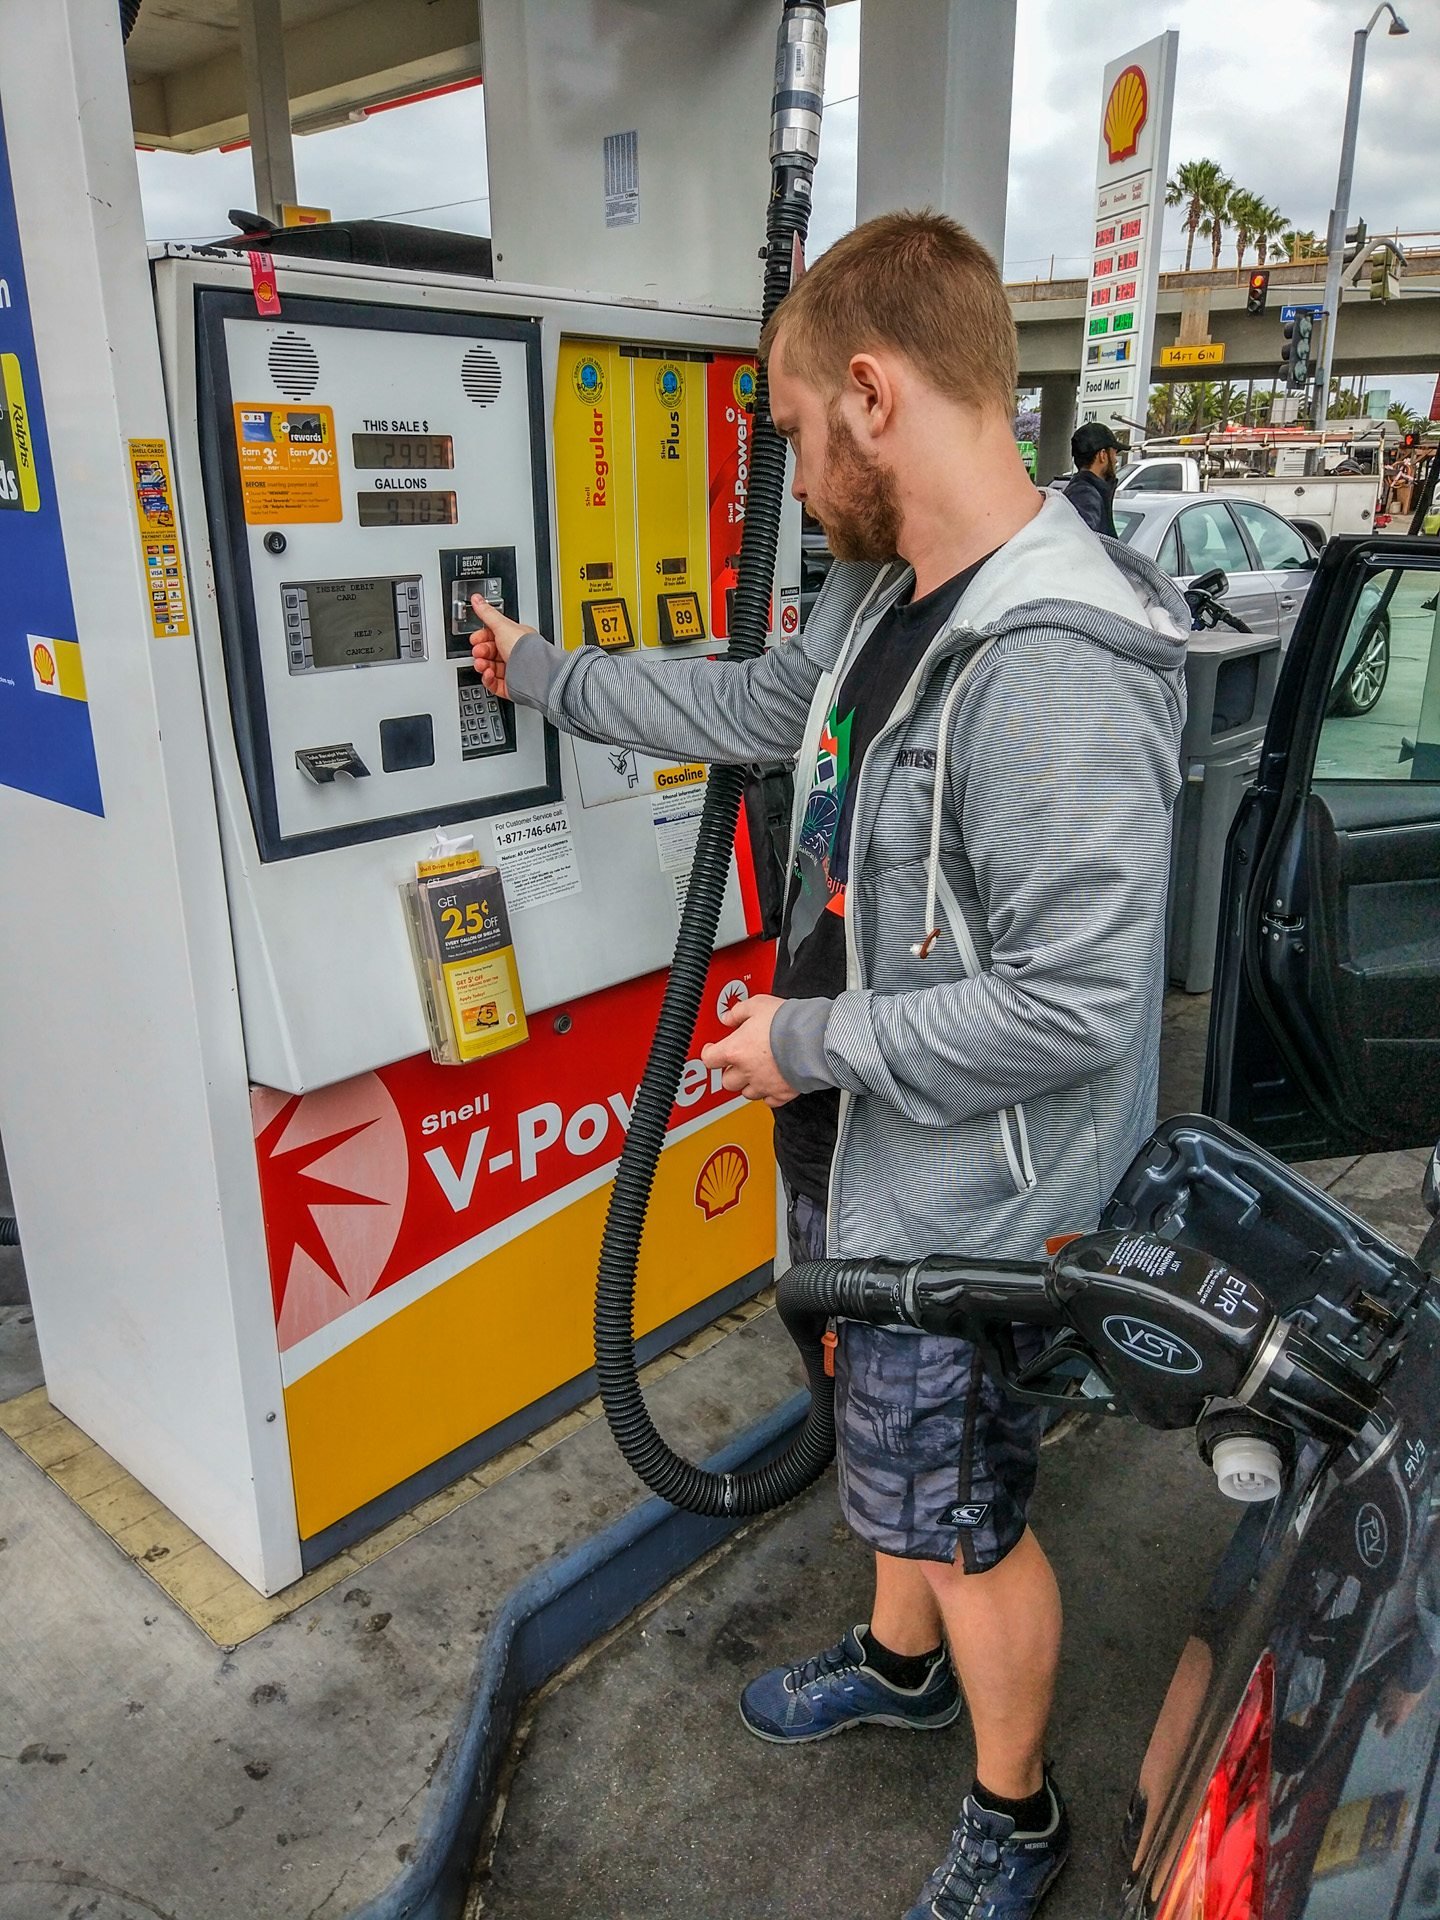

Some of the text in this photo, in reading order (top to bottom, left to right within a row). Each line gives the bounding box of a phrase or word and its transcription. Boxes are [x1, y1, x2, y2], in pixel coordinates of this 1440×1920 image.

[1086, 379, 1120, 392] Food Mart
[1084, 411, 1097, 422] ATM
[363, 420, 429, 433] THIS SALE $
[12, 402, 29, 468] Ralphs
[290, 433, 321, 442] rewards
[667, 411, 680, 459] Plus
[242, 447, 260, 456] Earn
[290, 448, 308, 457] Earn
[590, 408, 608, 506] Regular
[735, 414, 748, 524] V-Power
[374, 478, 427, 489] GALLONS
[580, 565, 585, 580] $
[656, 561, 661, 575] $
[316, 583, 374, 594] INSERT DEBIT
[336, 593, 356, 602] CARD
[676, 610, 692, 625] 89
[601, 617, 618, 633] 87
[354, 629, 372, 638] HELP
[346, 647, 375, 656] CANCEL
[657, 768, 704, 786] Gasoline
[505, 817, 532, 829] Customer
[533, 812, 553, 822] Service
[497, 820, 567, 846] 1-877-746-6472
[548, 839, 568, 848] Customers
[438, 895, 457, 908] GET
[440, 900, 498, 939] 25¢ OFF
[486, 1009, 493, 1019] 5
[421, 1093, 490, 1136] Shell
[1156, 1250, 1176, 1276] WARNING
[1170, 1260, 1182, 1272] VST
[1214, 1276, 1247, 1314] EVR
[1121, 1321, 1182, 1363] VST
